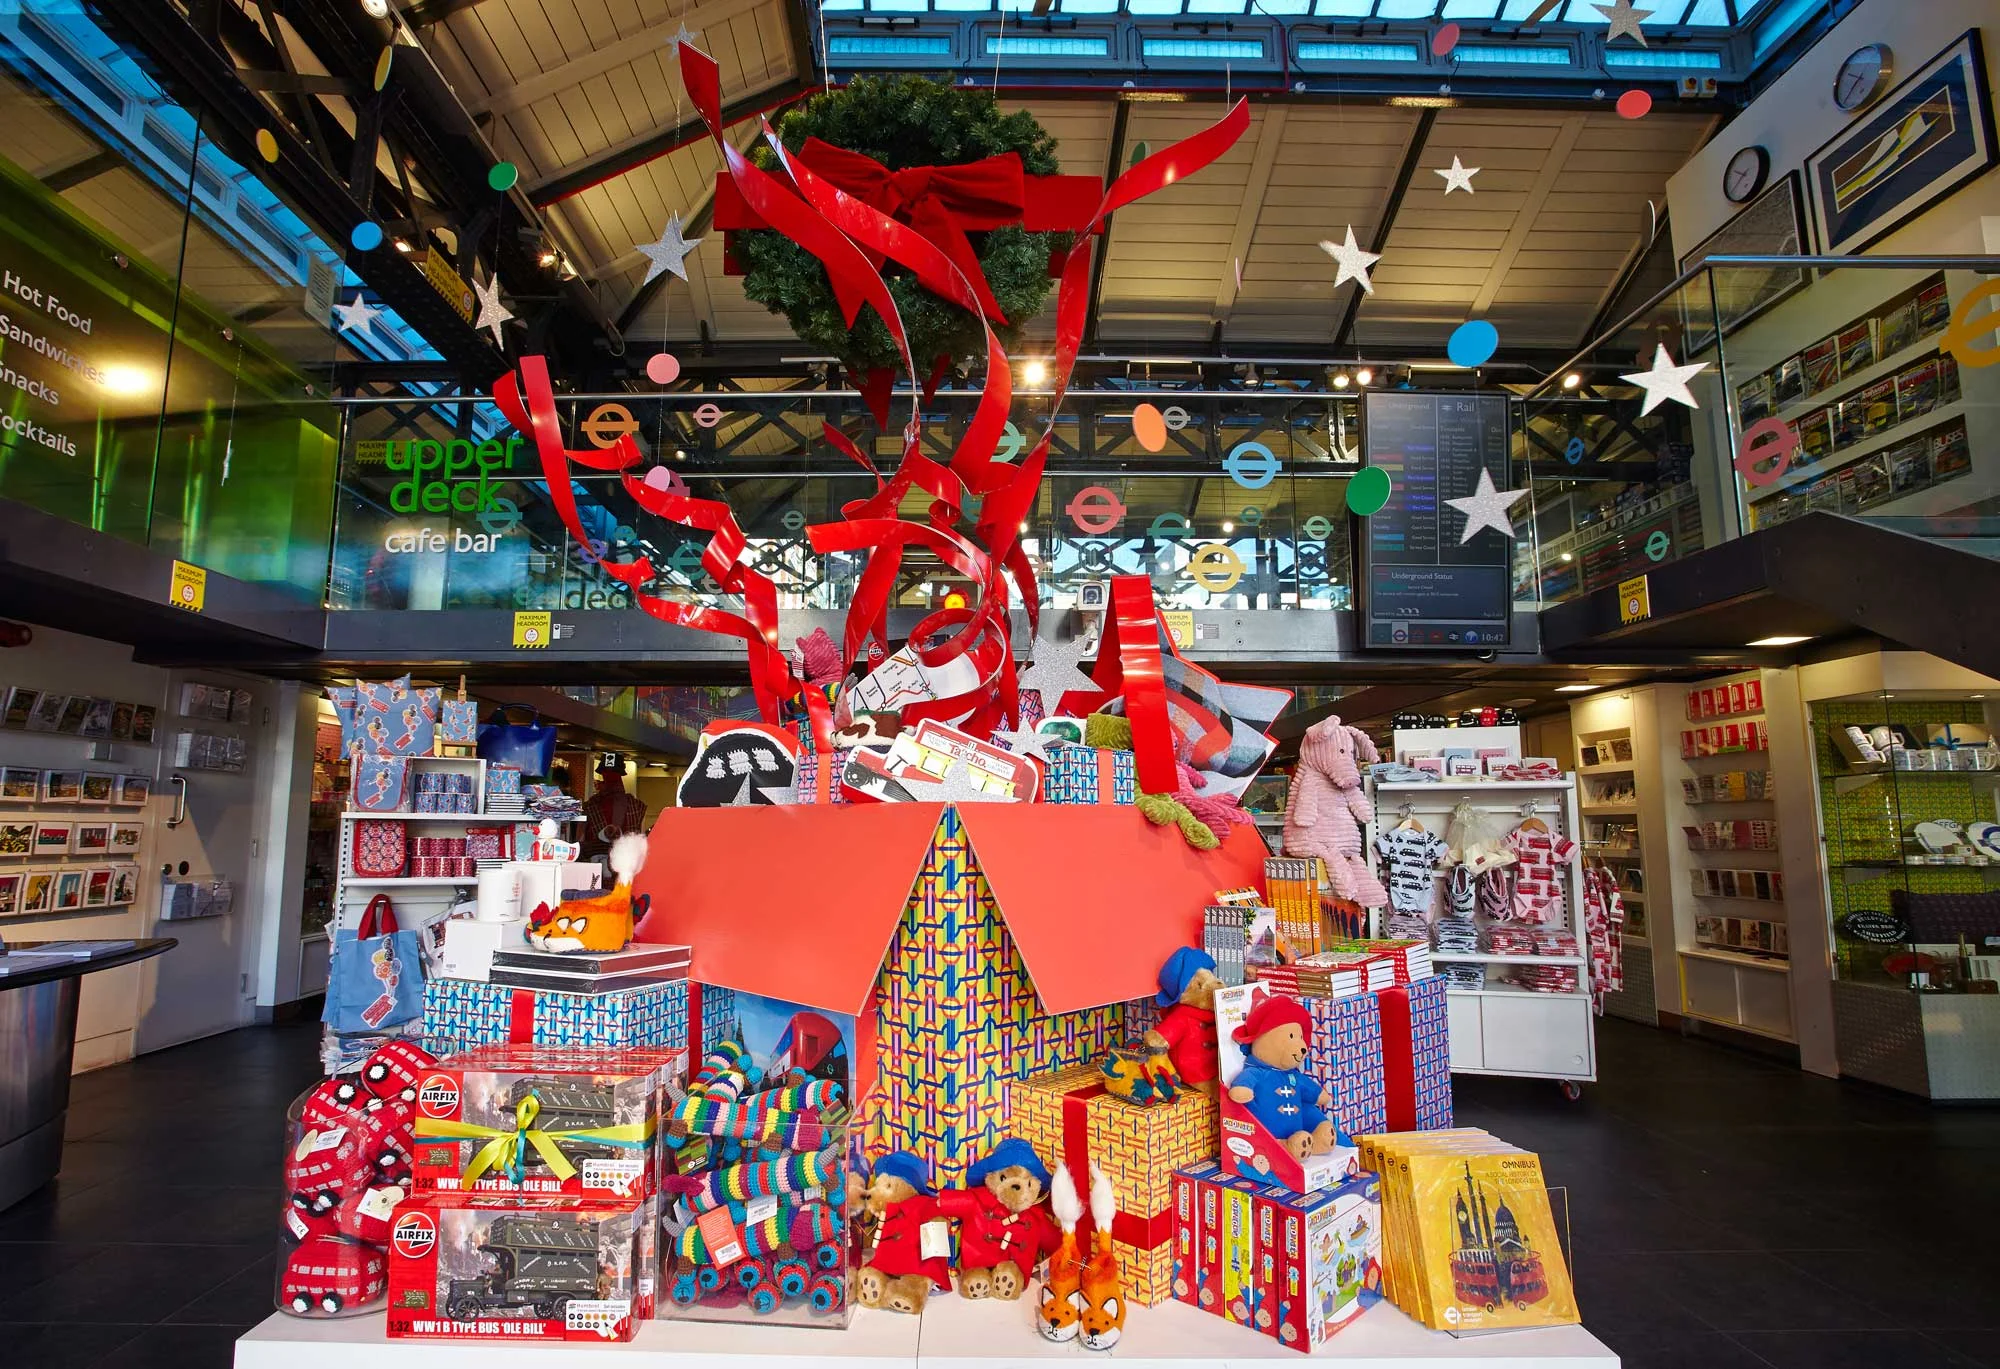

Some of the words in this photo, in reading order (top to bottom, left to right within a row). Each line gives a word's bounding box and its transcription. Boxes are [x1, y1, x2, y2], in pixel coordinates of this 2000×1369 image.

[3, 270, 43, 308] Hot
[46, 295, 92, 336] Food
[0, 314, 106, 385] Sandwiches
[1456, 401, 1475, 412] Rail
[0, 408, 77, 458] ocktails
[1933, 430, 1964, 450] BUSES
[386, 438, 524, 480] upper
[390, 467, 505, 513] deck
[385, 528, 447, 553] cafe
[454, 528, 503, 553] bar
[1391, 572, 1433, 581] Underground
[1434, 572, 1453, 580] Status
[421, 1091, 457, 1101] AIRFIX
[1502, 1160, 1536, 1169] OMNIBUS
[415, 1177, 434, 1189] 1:32
[437, 1178, 462, 1190] WW1
[474, 1178, 497, 1191] TYPE
[499, 1179, 519, 1191] BUS
[396, 1230, 434, 1240] AIRFIX
[389, 1321, 410, 1333] 1:32
[413, 1320, 441, 1333] WW1
[443, 1321, 450, 1333] B
[452, 1322, 477, 1333] TYPE
[478, 1322, 500, 1334] BUS
